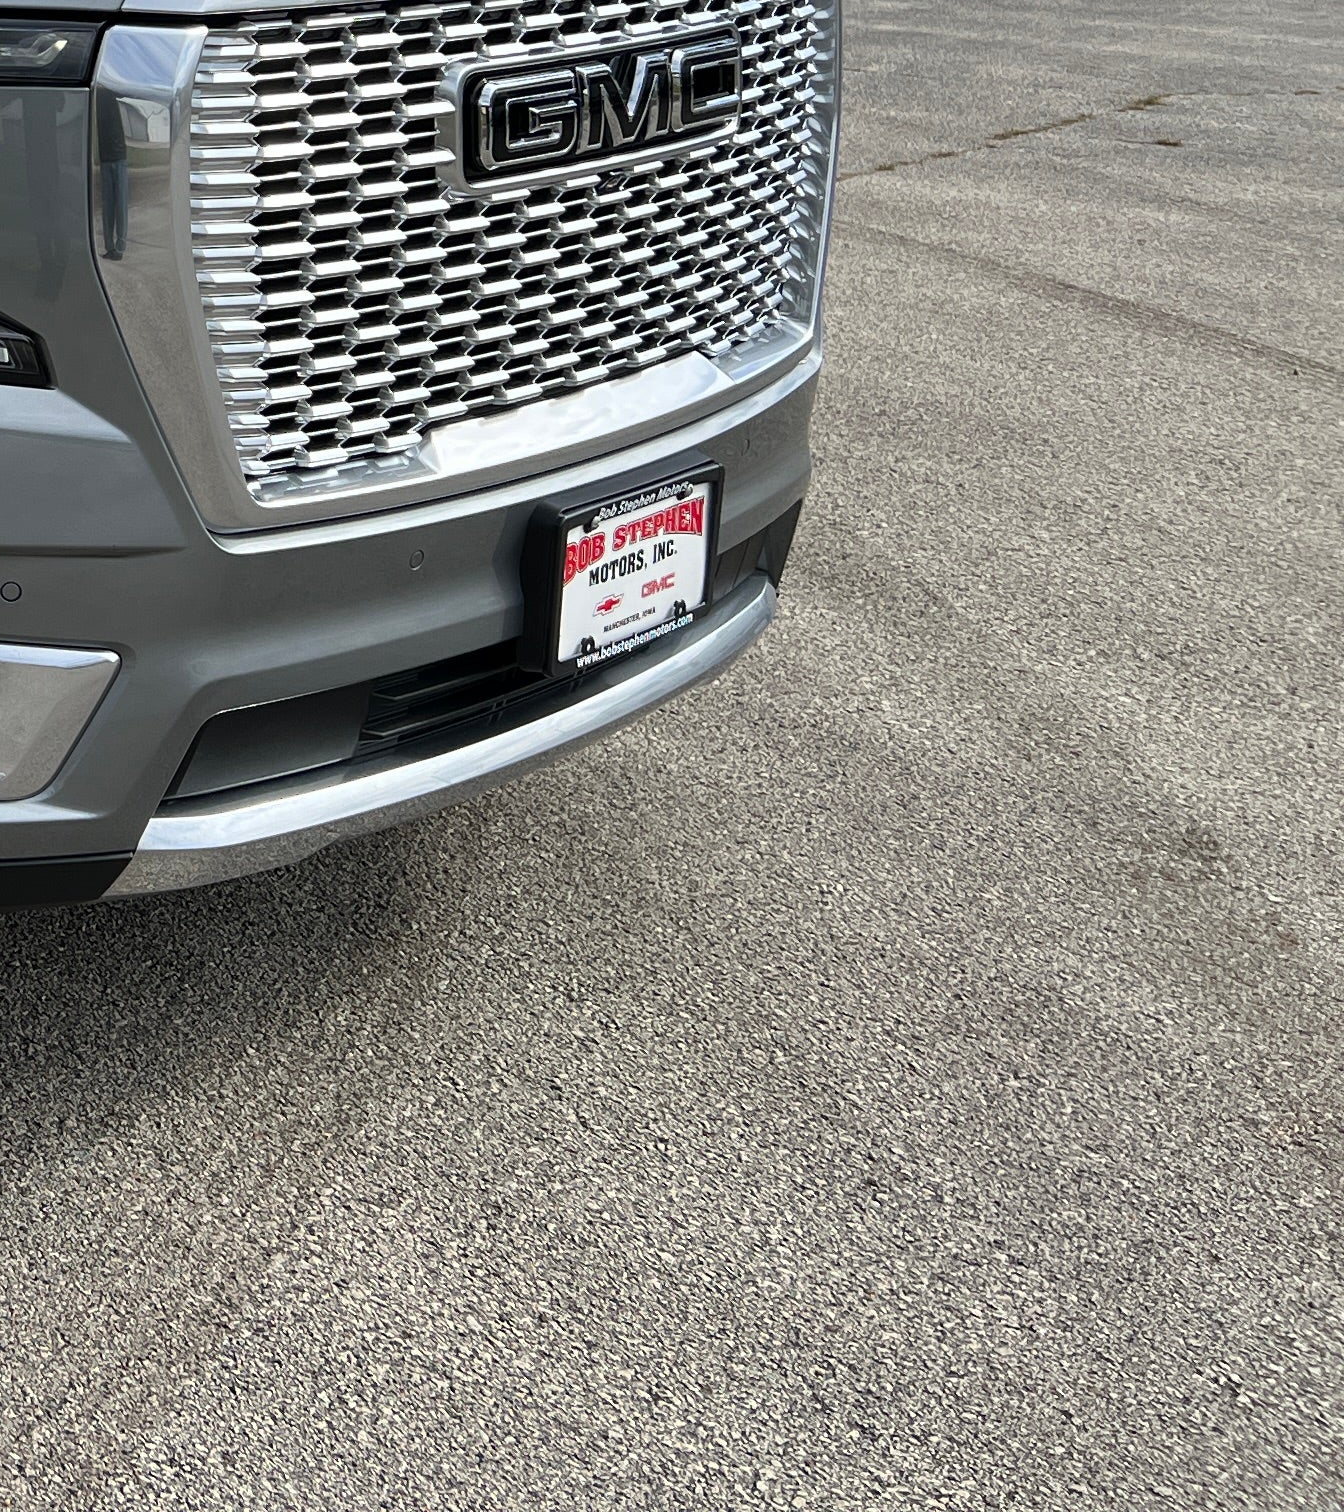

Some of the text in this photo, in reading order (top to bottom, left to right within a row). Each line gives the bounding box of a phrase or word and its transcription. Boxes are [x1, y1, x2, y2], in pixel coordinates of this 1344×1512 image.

[479, 35, 741, 171] GMC
[564, 496, 705, 586] BOB STEPHEN
[653, 539, 678, 564] INC.
[640, 572, 676, 598] GMC
[576, 612, 694, 668] www.bobstephenmotors.com
